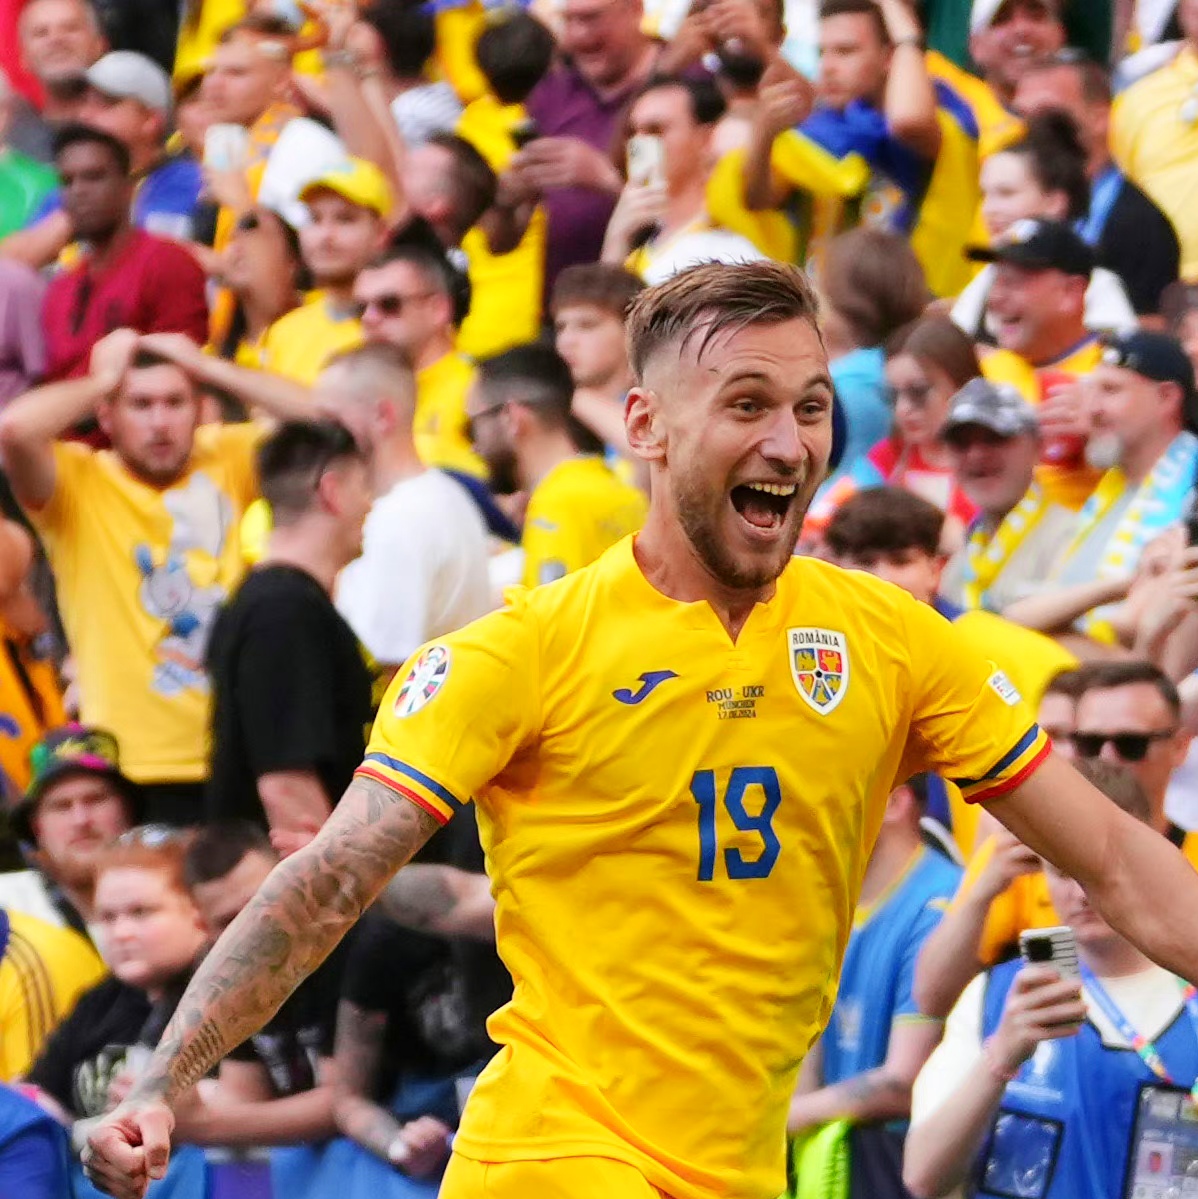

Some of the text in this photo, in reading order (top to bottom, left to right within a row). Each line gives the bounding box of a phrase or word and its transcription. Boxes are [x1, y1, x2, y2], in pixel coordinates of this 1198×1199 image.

[792, 630, 840, 647] ROMÂNIA
[705, 688, 733, 703] ROU
[742, 685, 765, 698] UKR
[689, 766, 782, 881] 19
